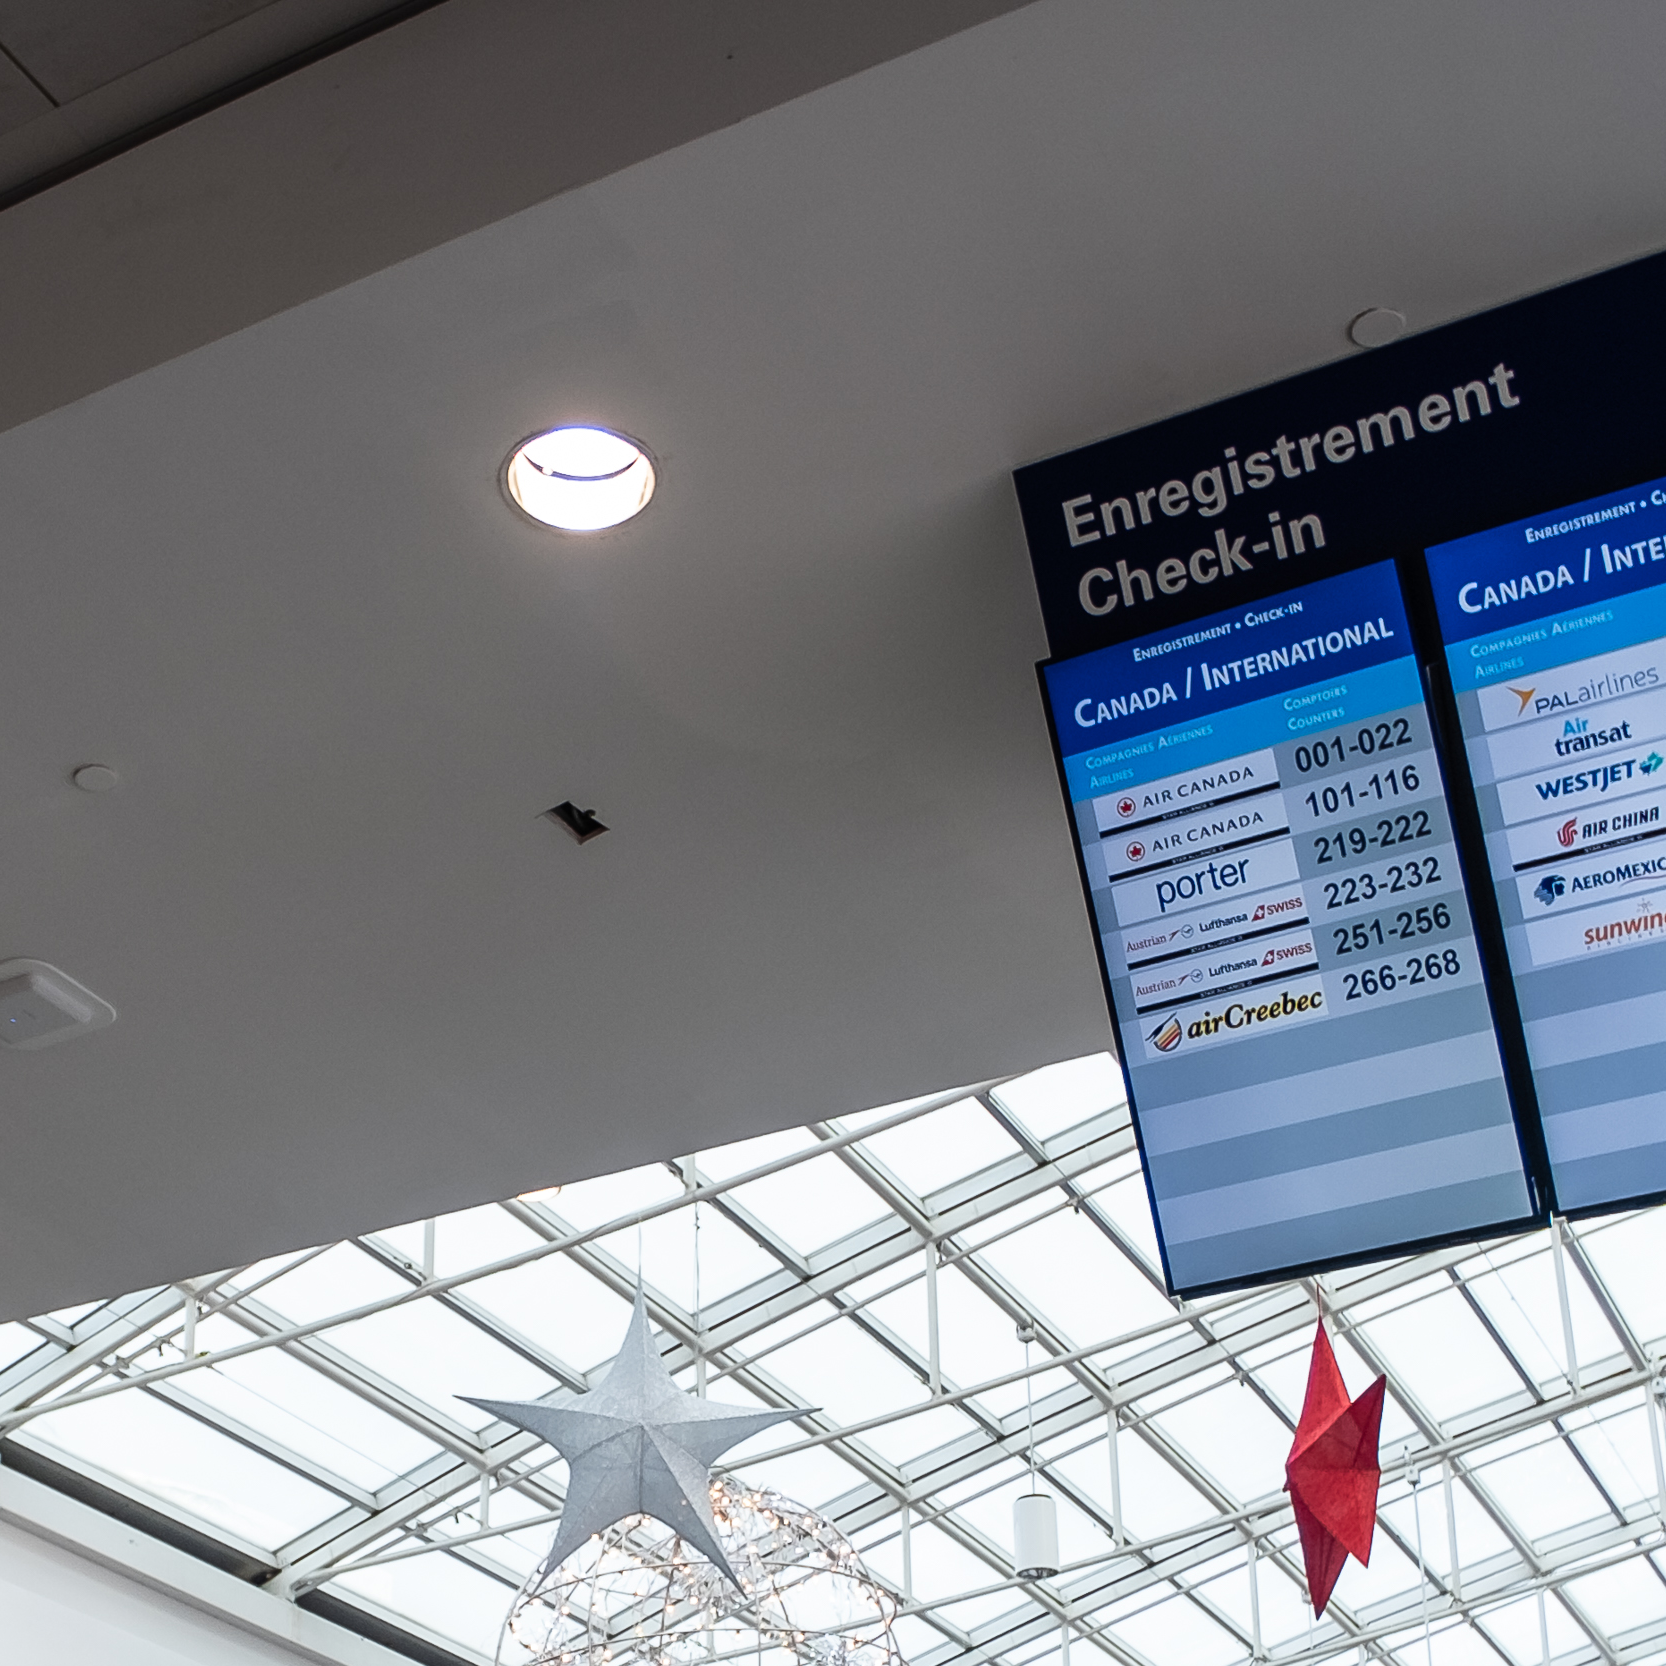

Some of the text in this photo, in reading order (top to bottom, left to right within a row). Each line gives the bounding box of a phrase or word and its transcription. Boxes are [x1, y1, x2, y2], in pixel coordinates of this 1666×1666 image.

[1062, 362, 1520, 548] Enregistrement
[1525, 501, 1637, 544] ENREGISTREMENT
[1077, 506, 1326, 617] Check-in
[1458, 564, 1574, 615] CANADA
[1132, 601, 1304, 663] ENREGISTREMENT CHECK-IN
[1074, 680, 1177, 728] CANADA
[1201, 617, 1394, 691] INTERNATIONAL
[1294, 717, 1413, 774] 001-022
[1554, 720, 1633, 757] transat
[1562, 716, 1590, 738] Air
[1142, 766, 1254, 809] AIR CANADA
[1305, 764, 1421, 817] 101-116
[1535, 760, 1636, 801] WESTJET
[1152, 811, 1264, 854] AIR CANADA
[1314, 809, 1432, 866] 219-222
[1581, 806, 1660, 840] AIR CHINA
[1156, 857, 1250, 913] porter
[1323, 856, 1442, 911] 223-232
[1126, 897, 1303, 954] Austrian Lufthansa SWISS
[1333, 902, 1452, 956] 251-256
[1135, 943, 1313, 998] Austrian Lufthansa SWISS
[1343, 948, 1461, 1001] 266-268
[1187, 988, 1323, 1040] airCreebec
